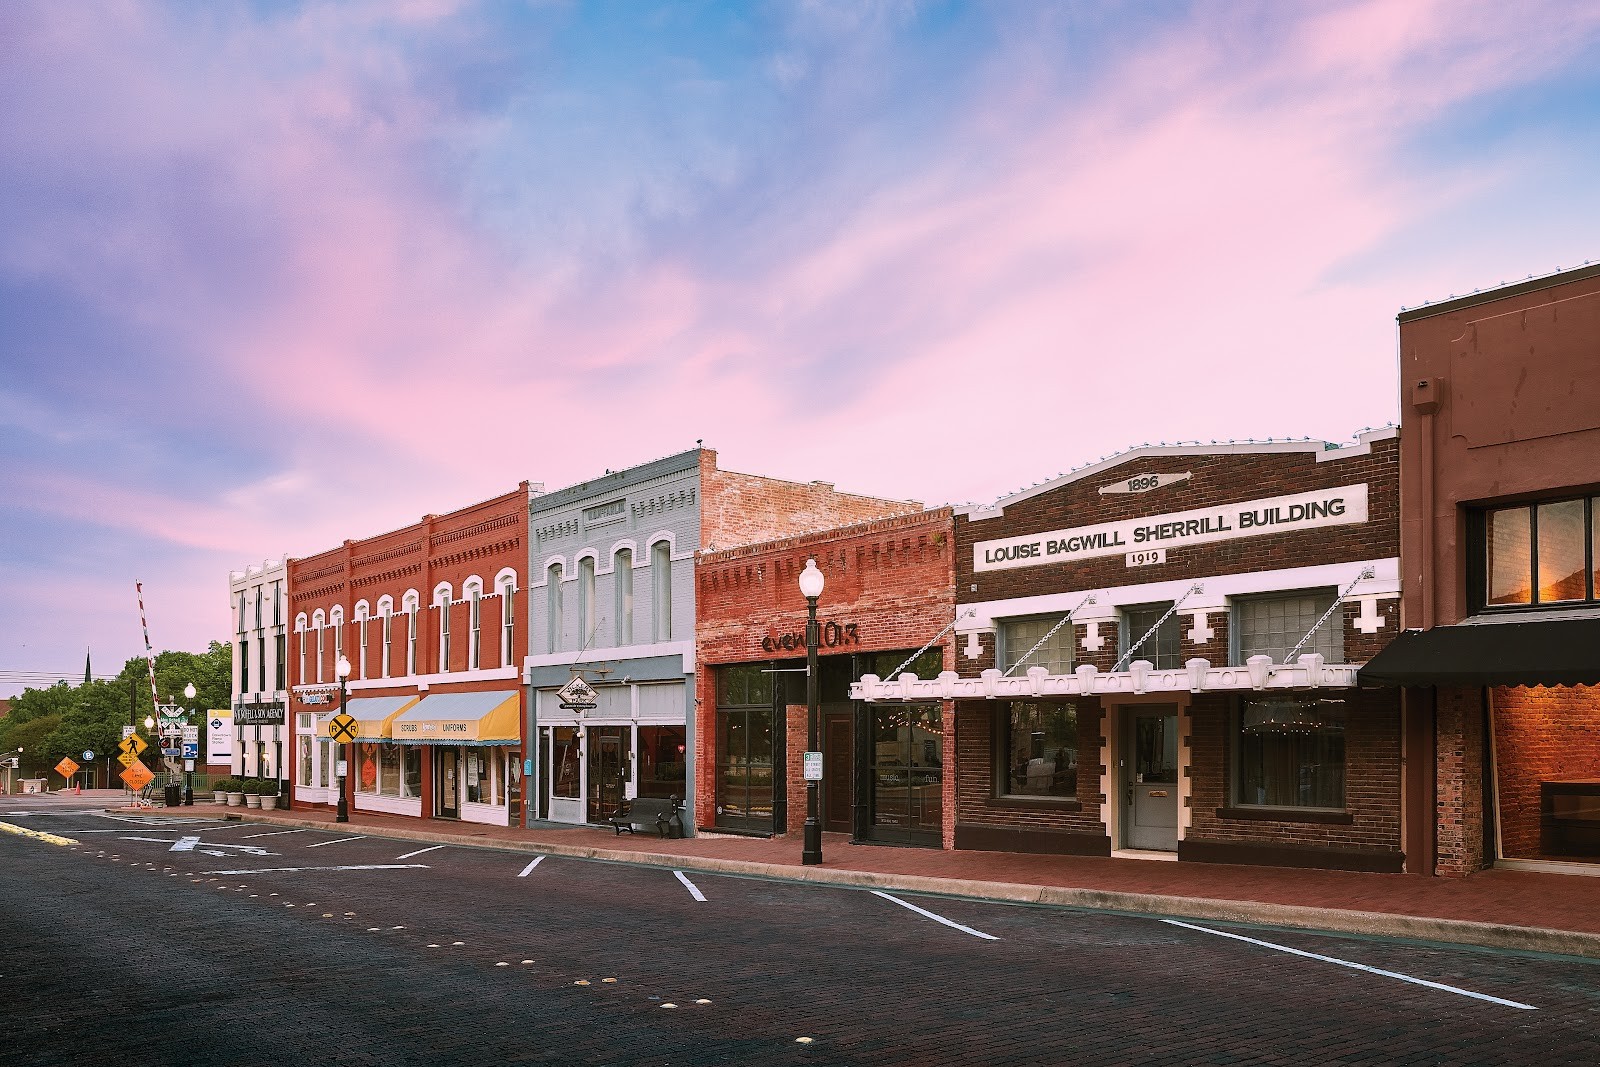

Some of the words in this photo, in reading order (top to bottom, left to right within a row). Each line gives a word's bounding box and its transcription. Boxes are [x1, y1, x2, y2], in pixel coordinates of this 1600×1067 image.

[1127, 475, 1159, 492] 1896
[985, 541, 1041, 564] LOUISE
[1046, 530, 1126, 556] BAGWILL
[1133, 515, 1232, 543] SHERRILL
[1239, 498, 1346, 529] BUILDING
[1131, 551, 1159, 565] 1919
[566, 684, 591, 692] VICKERY
[266, 708, 284, 719] AGENCY
[331, 725, 338, 733] R
[350, 725, 357, 733] R
[401, 724, 417, 732] SCRUBS
[442, 723, 467, 732] UNIFORMS
[183, 745, 191, 756] P
[924, 774, 940, 783] fun.
